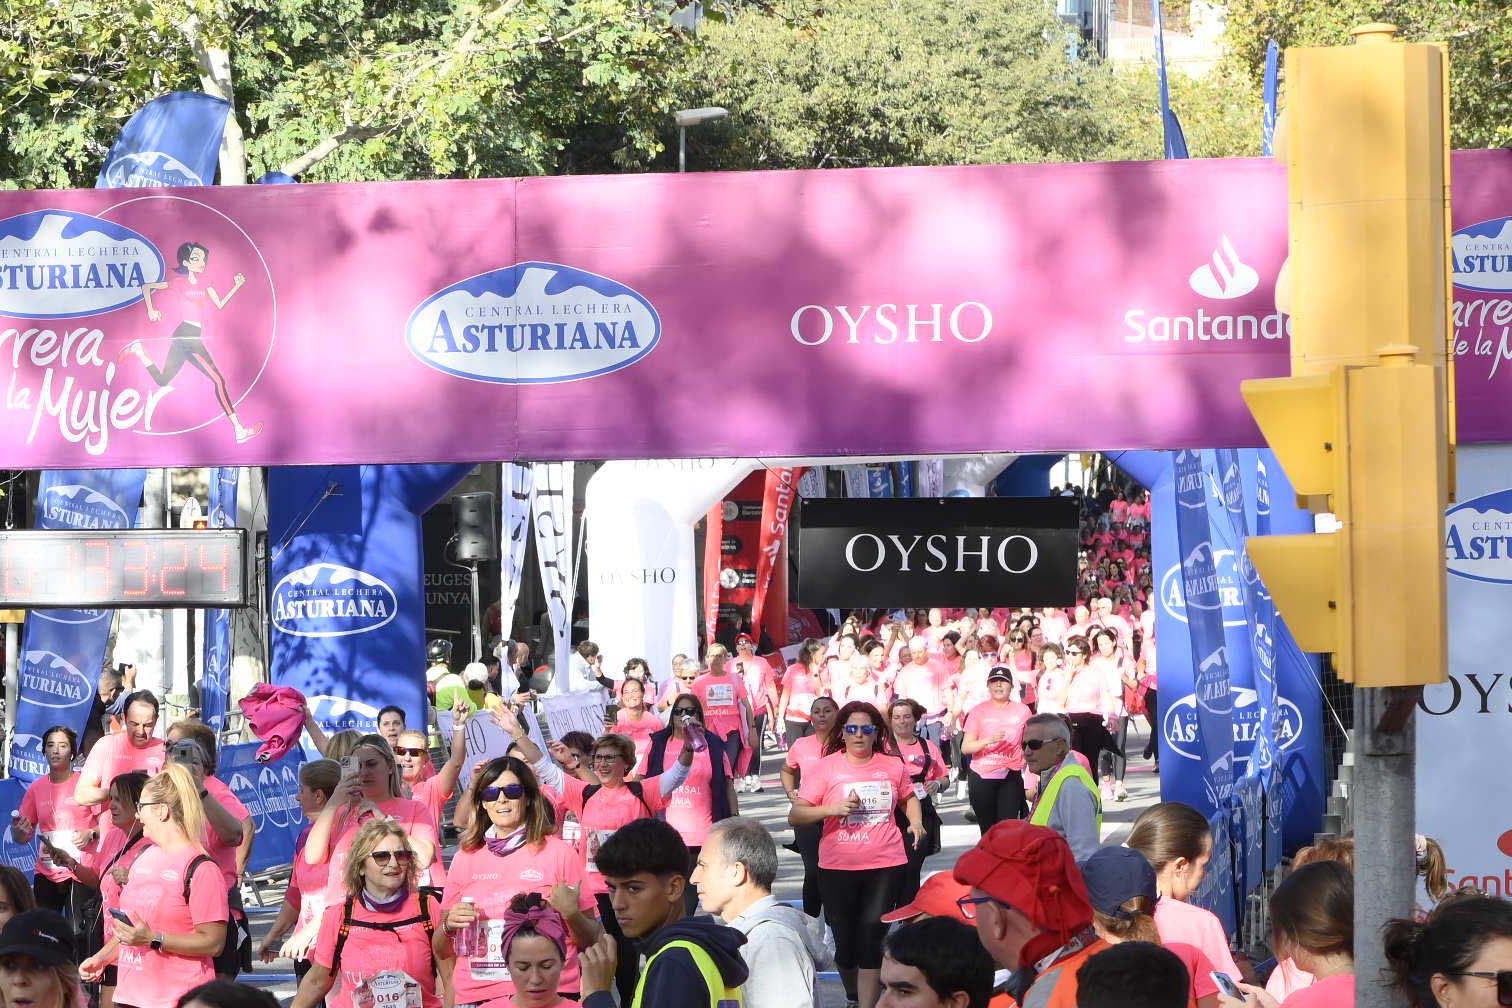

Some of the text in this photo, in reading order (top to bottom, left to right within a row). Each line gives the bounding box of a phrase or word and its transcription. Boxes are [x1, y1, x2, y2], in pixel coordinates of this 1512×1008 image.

[69, 246, 140, 258] LECHERA
[465, 303, 632, 318] CENTRAL LECHERA
[790, 300, 993, 346] OYSHO
[427, 309, 641, 353] ASTURIANA
[1475, 328, 1492, 356] la
[7, 373, 32, 409] la
[26, 360, 175, 456] Mujer
[845, 533, 1038, 574] OYSHO
[276, 593, 388, 621] ASTURIANA
[287, 588, 383, 598] CENTRAL LECHERA
[377, 993, 399, 1003] 016
